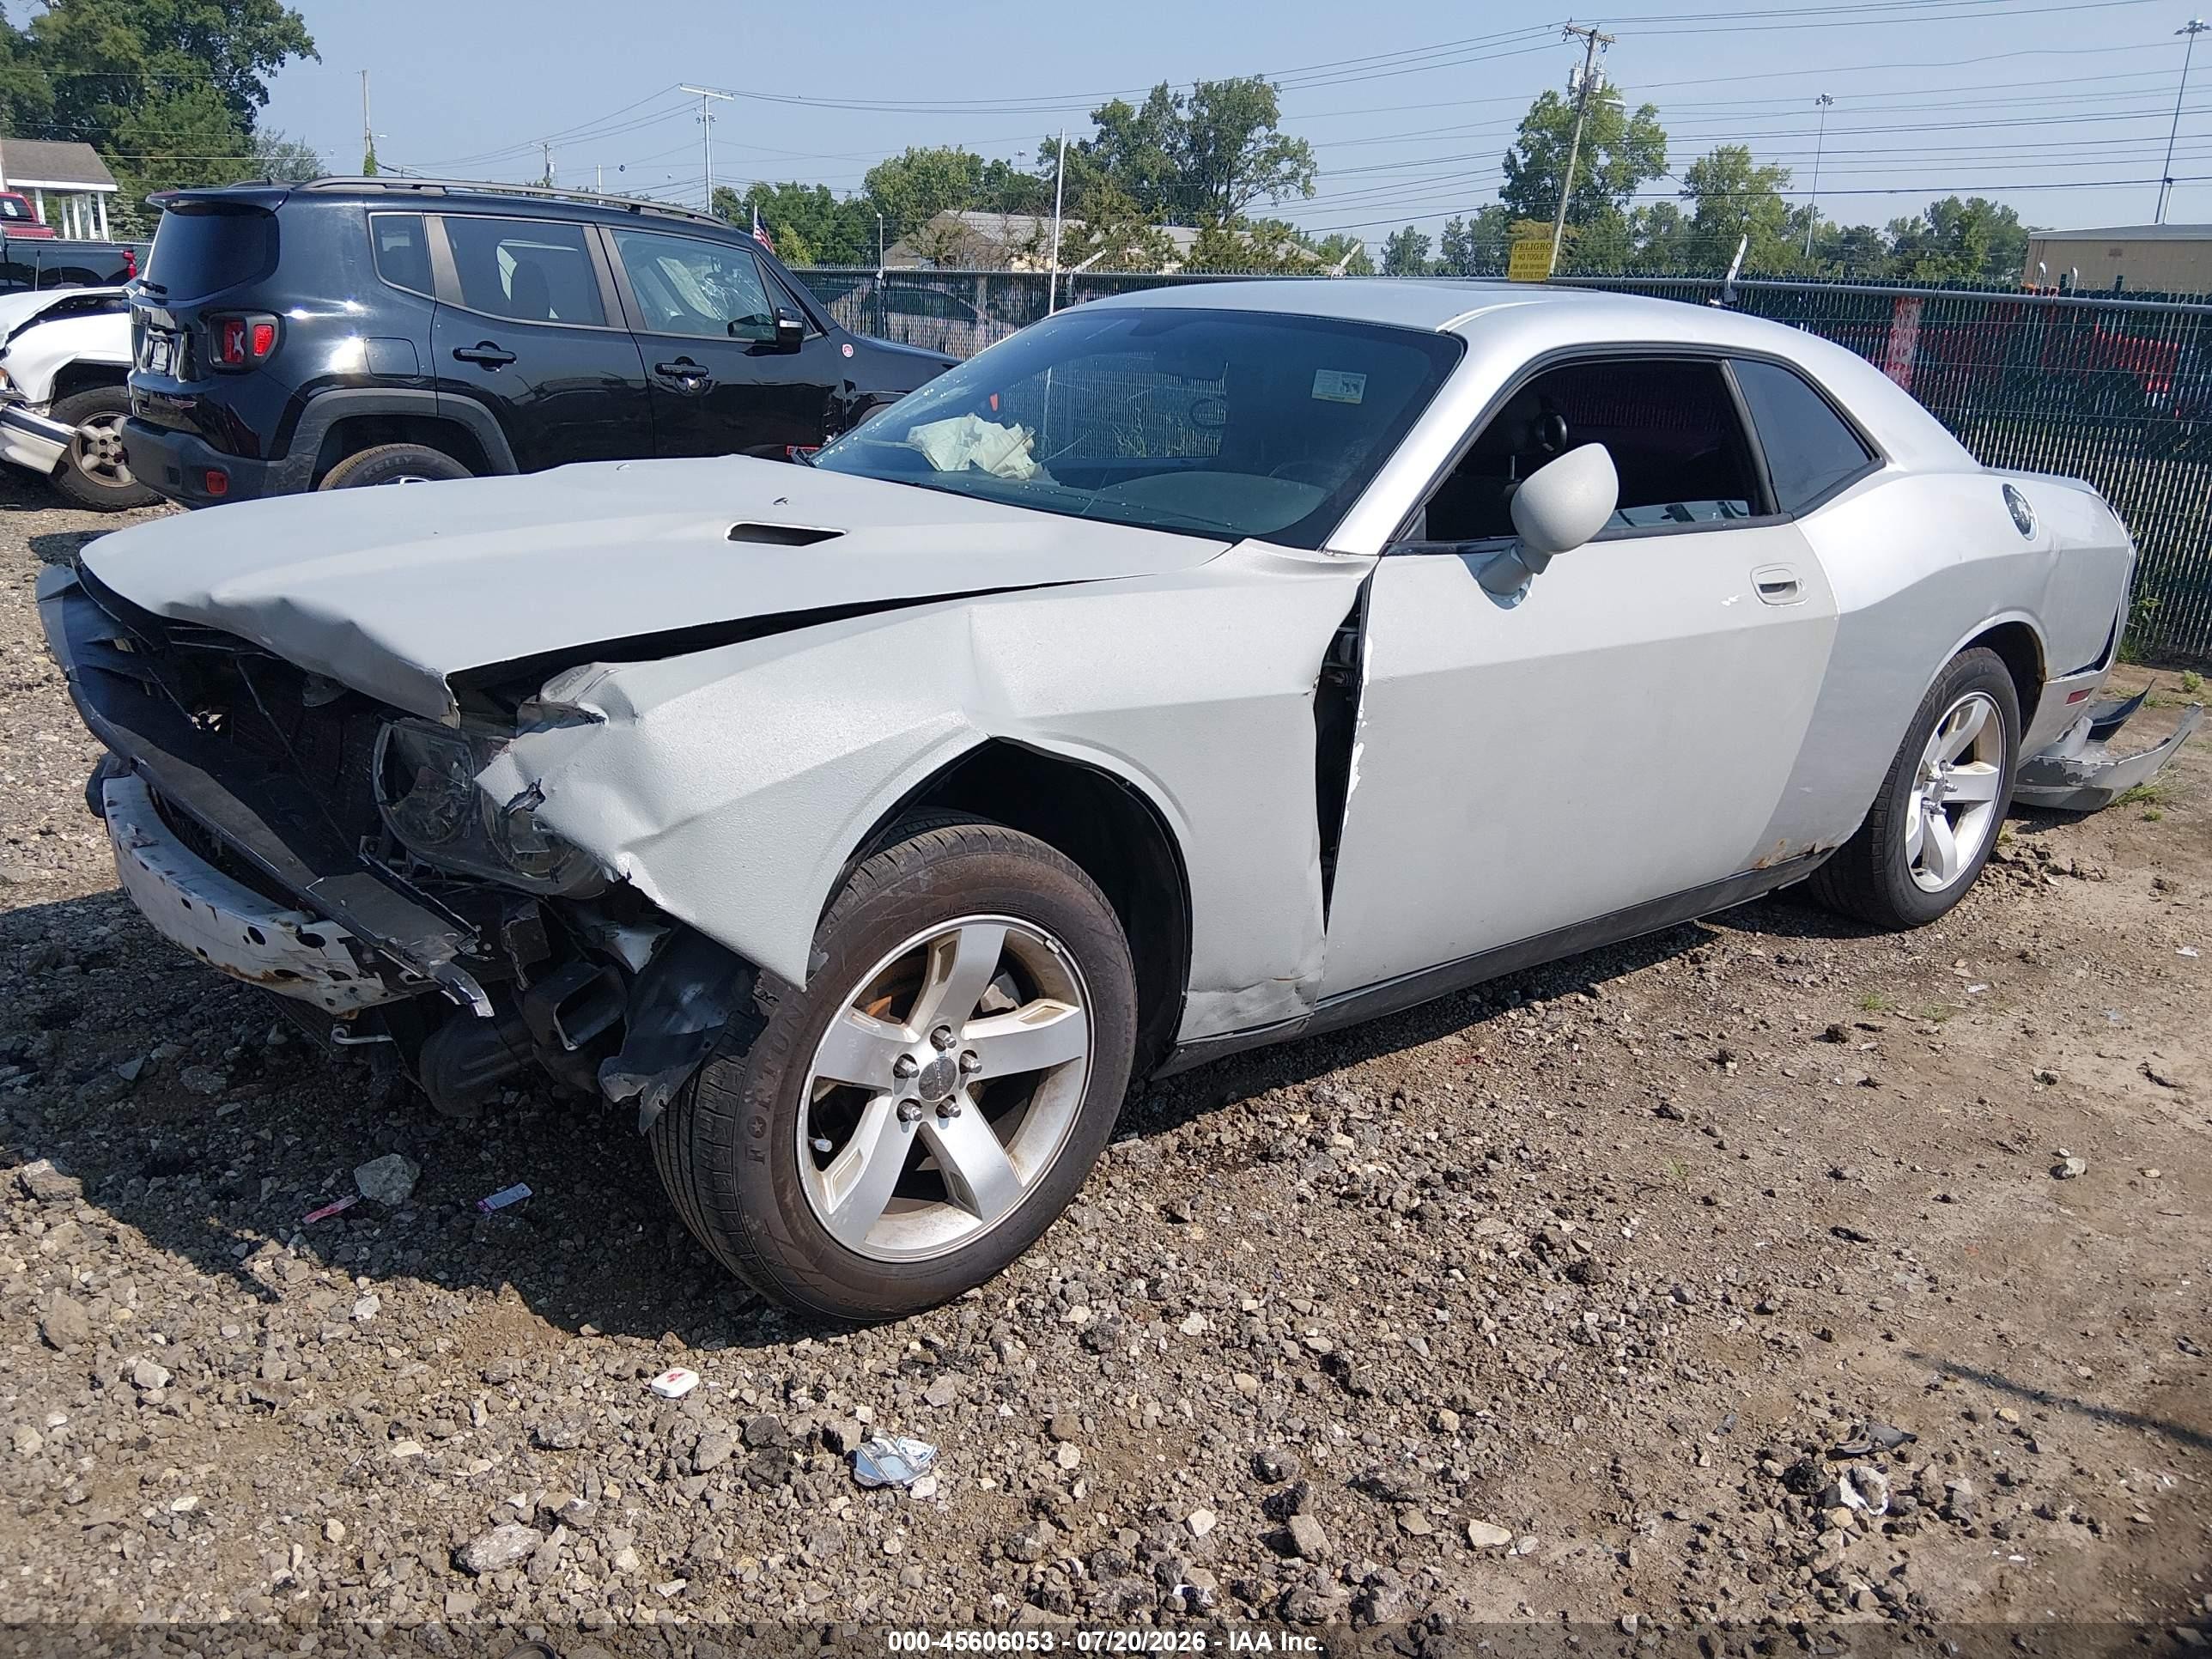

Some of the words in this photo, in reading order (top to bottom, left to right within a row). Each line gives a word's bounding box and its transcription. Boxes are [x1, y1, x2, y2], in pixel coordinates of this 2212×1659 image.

[1514, 242, 1553, 251] PELIGRO
[1527, 252, 1545, 261] TOQUE
[363, 455, 413, 479] KELLY
